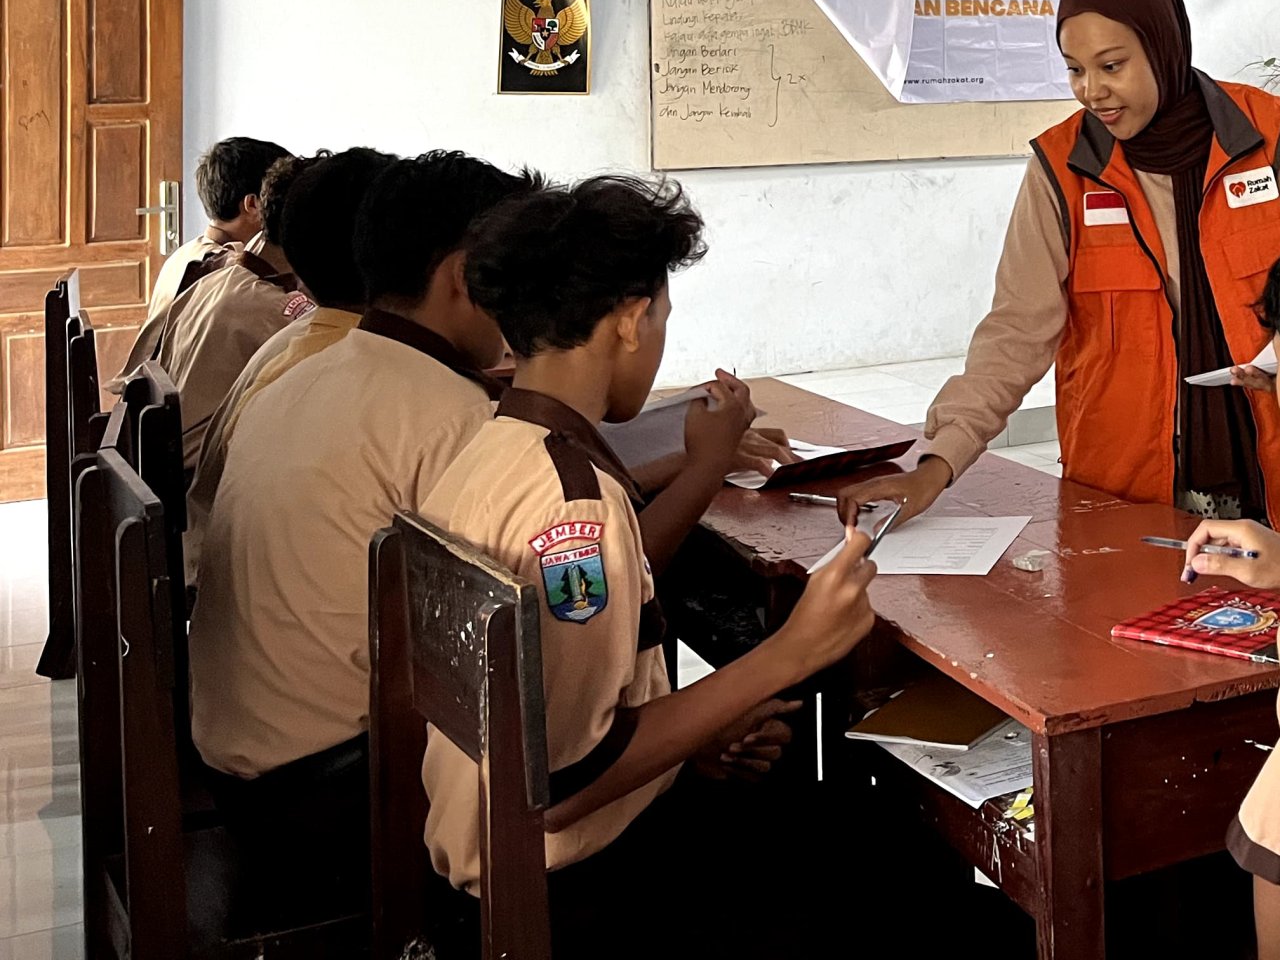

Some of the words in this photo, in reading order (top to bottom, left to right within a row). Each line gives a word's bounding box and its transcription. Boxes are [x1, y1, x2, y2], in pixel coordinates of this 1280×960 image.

[945, 0, 1055, 17] BENCANA
[661, 62, 697, 78] Jangan
[1247, 176, 1272, 186] Rumah
[1249, 184, 1268, 194] Zakat
[538, 524, 597, 548] JEMBER
[542, 553, 569, 565] JAWA
